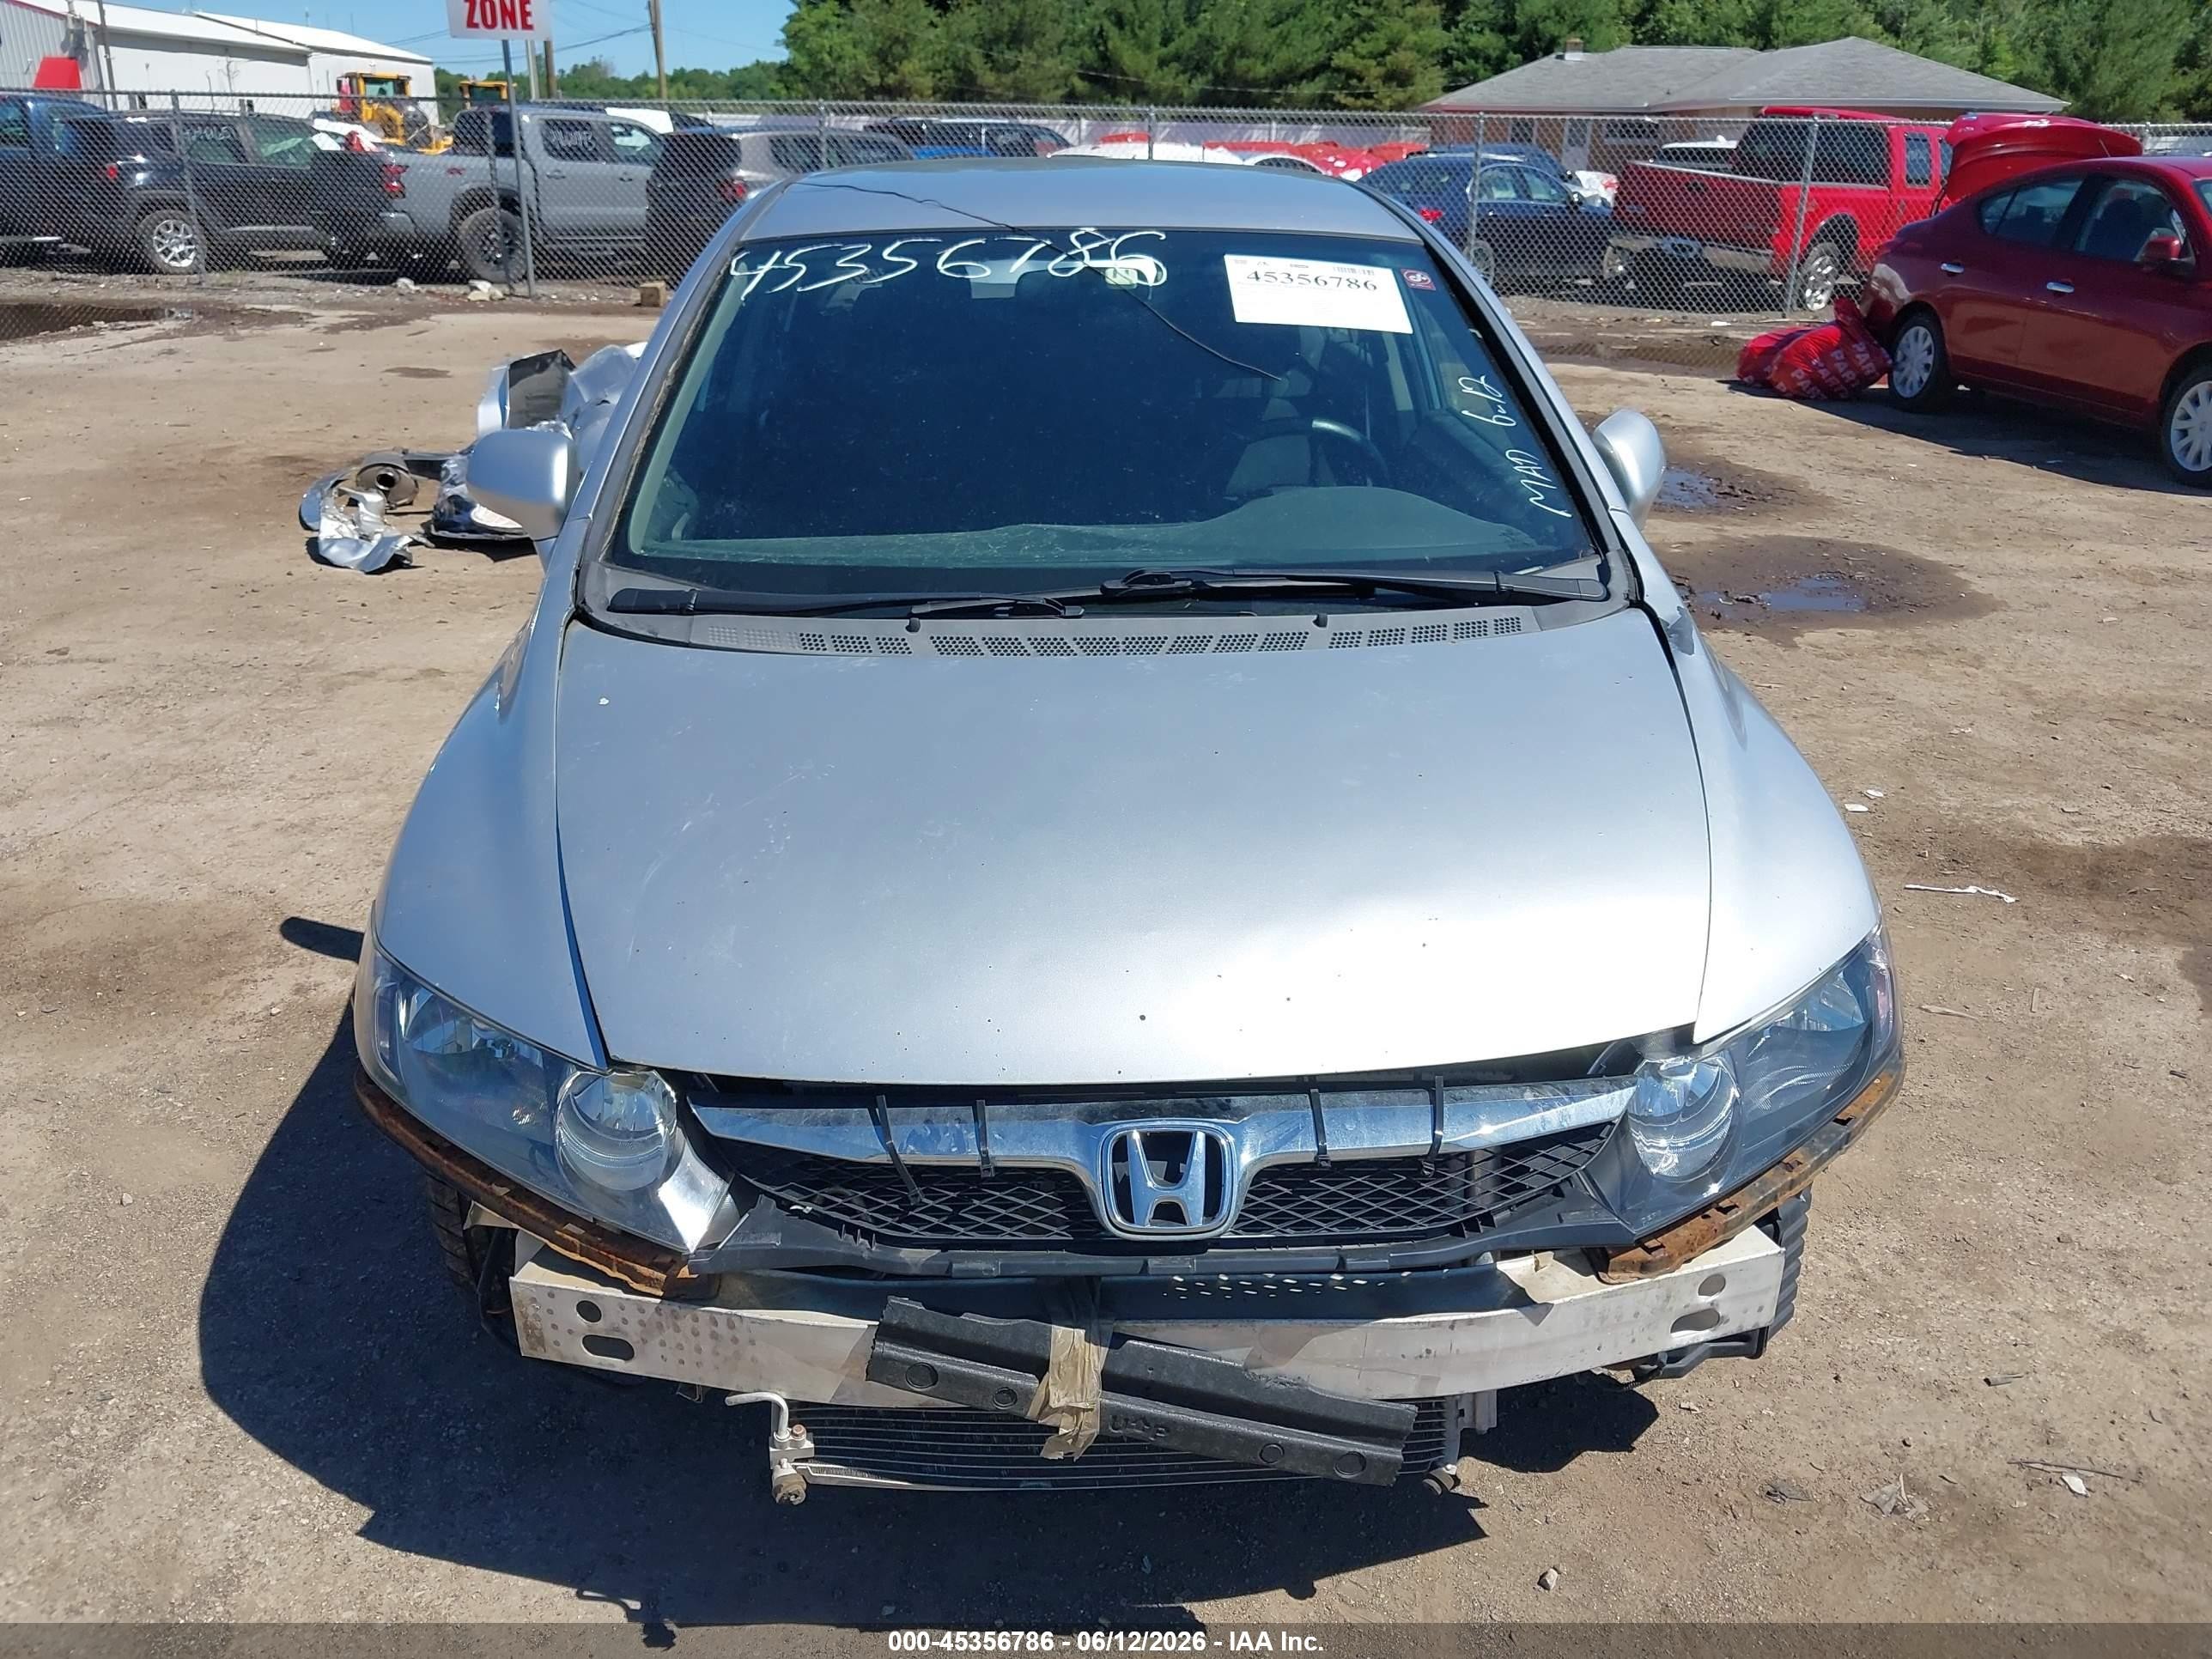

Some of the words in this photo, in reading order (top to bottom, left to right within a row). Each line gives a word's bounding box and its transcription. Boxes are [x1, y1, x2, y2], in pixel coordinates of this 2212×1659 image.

[464, 0, 534, 30] ZONE
[729, 227, 1168, 301] 45356786
[1247, 270, 1377, 291] 45356786
